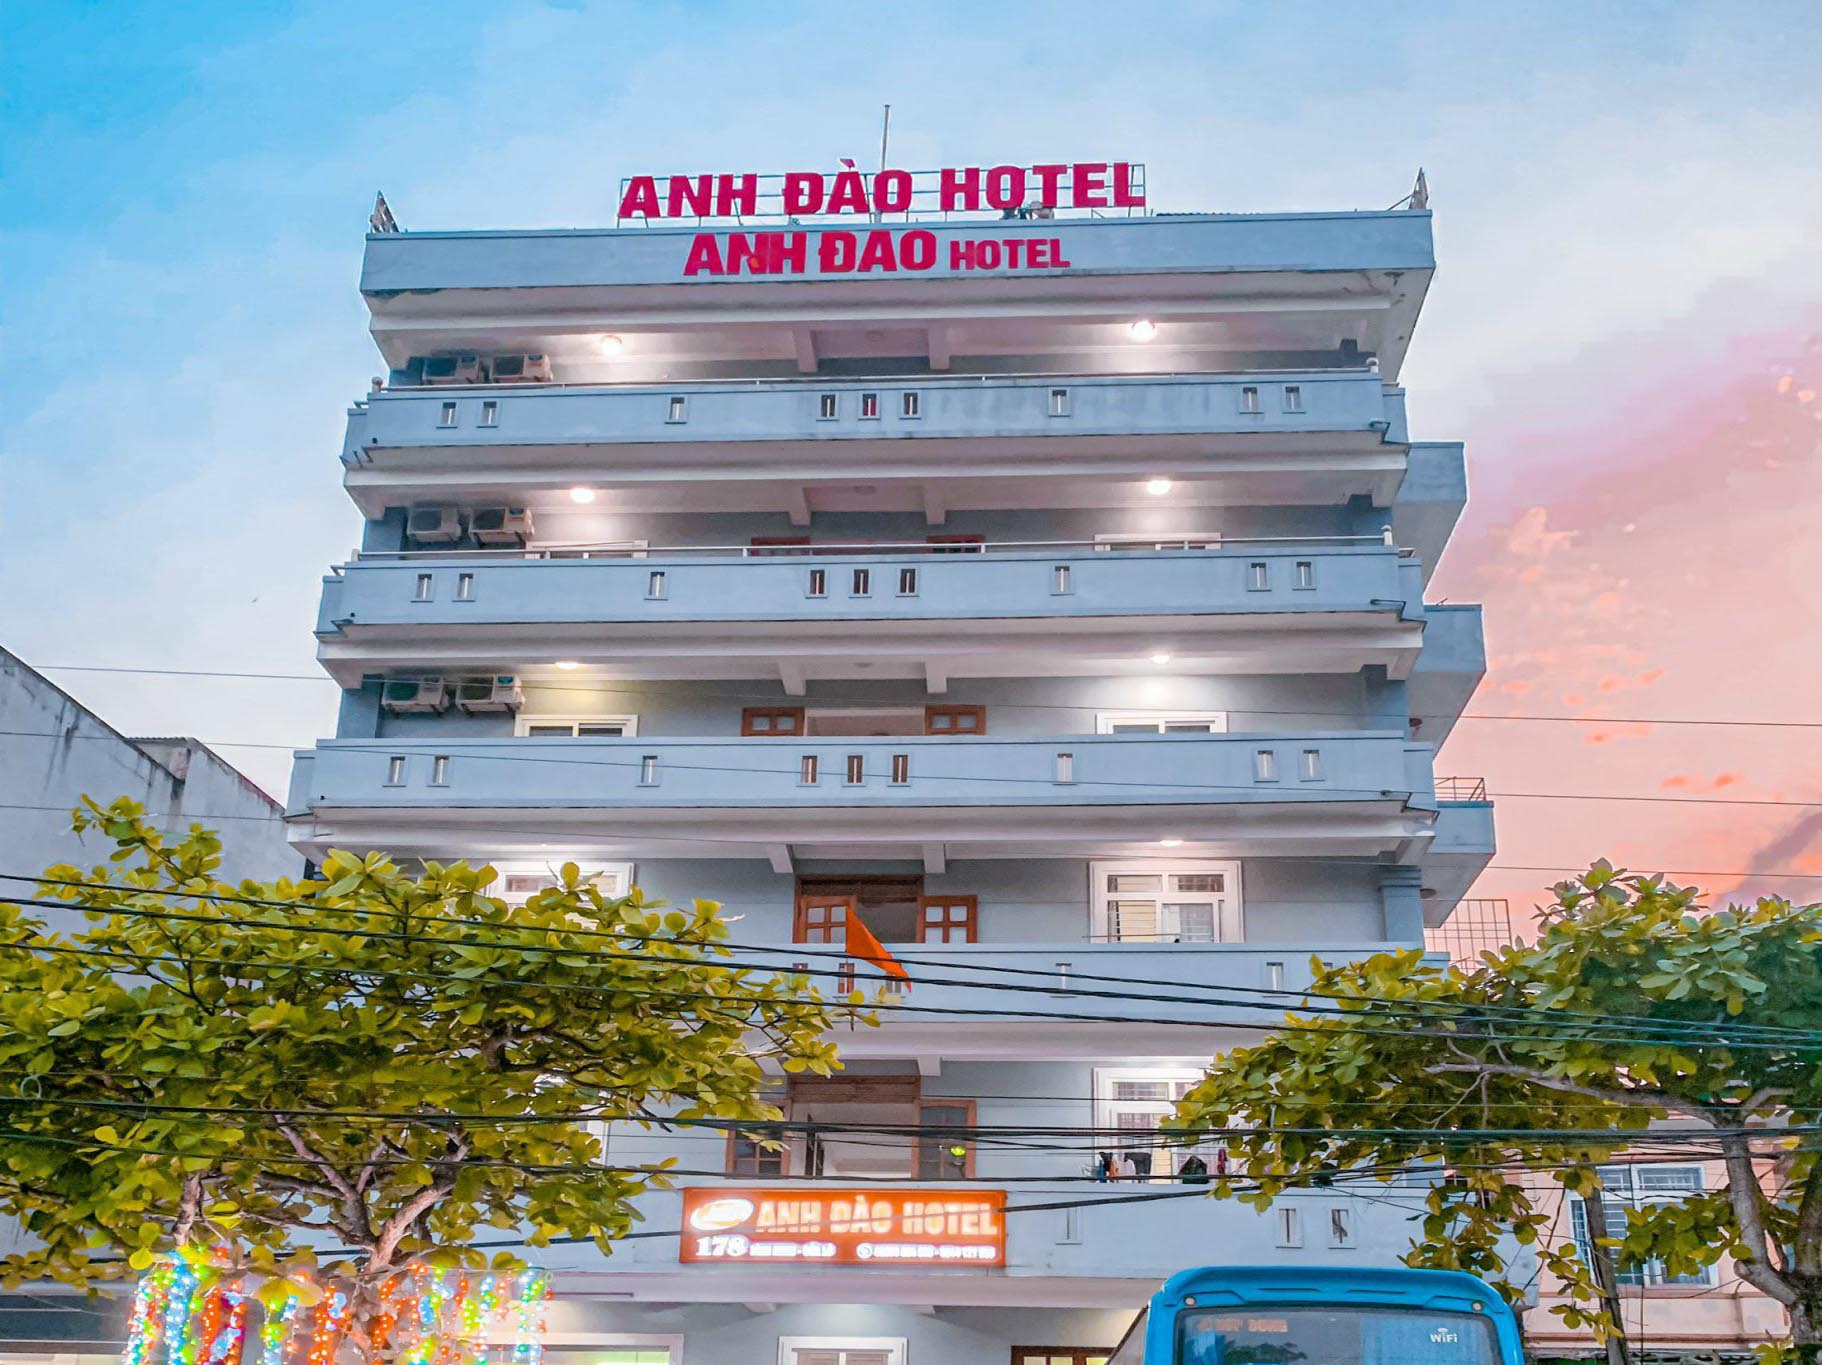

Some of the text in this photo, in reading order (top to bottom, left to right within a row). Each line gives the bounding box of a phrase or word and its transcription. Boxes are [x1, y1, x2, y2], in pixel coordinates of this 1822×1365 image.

[618, 158, 1146, 218] ANH ĐÀO HOTEL
[683, 229, 1070, 276] ANH ĐAO HOTEL
[755, 1200, 822, 1233] ANH
[902, 1202, 998, 1236] HOTEL
